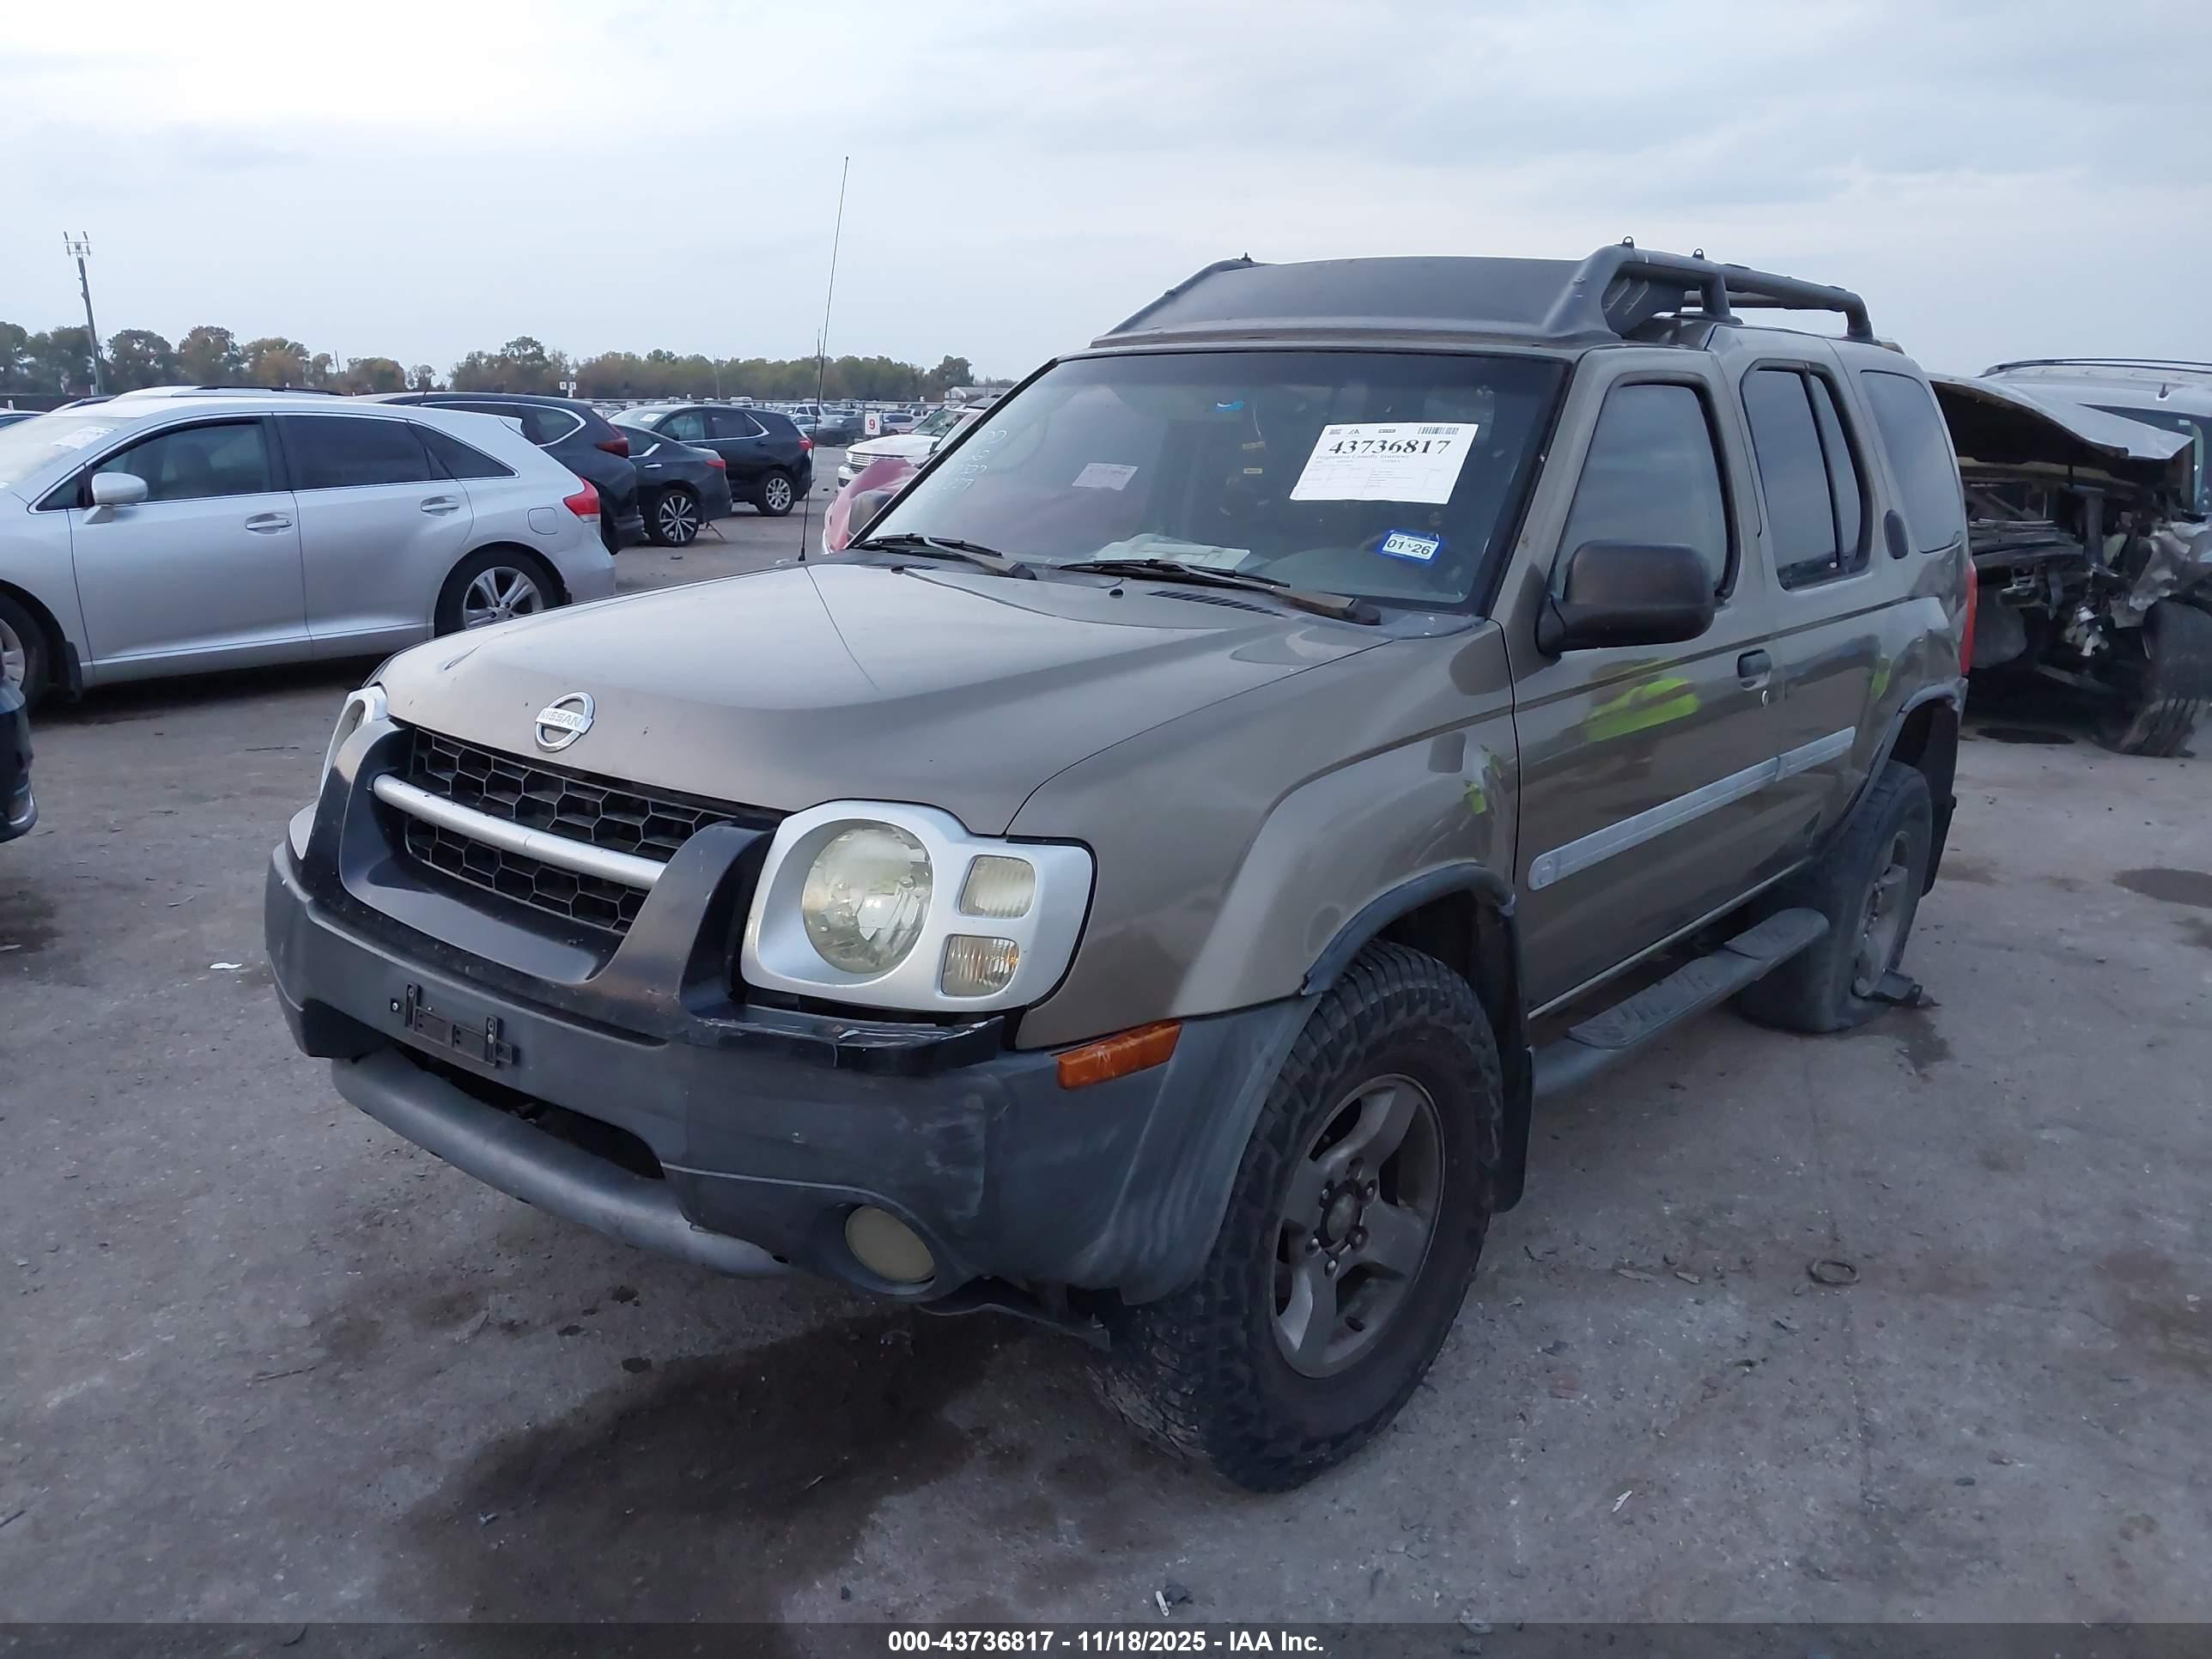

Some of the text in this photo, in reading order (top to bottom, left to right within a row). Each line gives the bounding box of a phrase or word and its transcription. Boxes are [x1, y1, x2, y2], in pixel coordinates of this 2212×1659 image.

[868, 418, 876, 430] 9
[1328, 439, 1451, 453] 43736817
[1387, 538, 1406, 550] 01
[1411, 544, 1432, 555] 26
[540, 710, 582, 727] NISSAN
